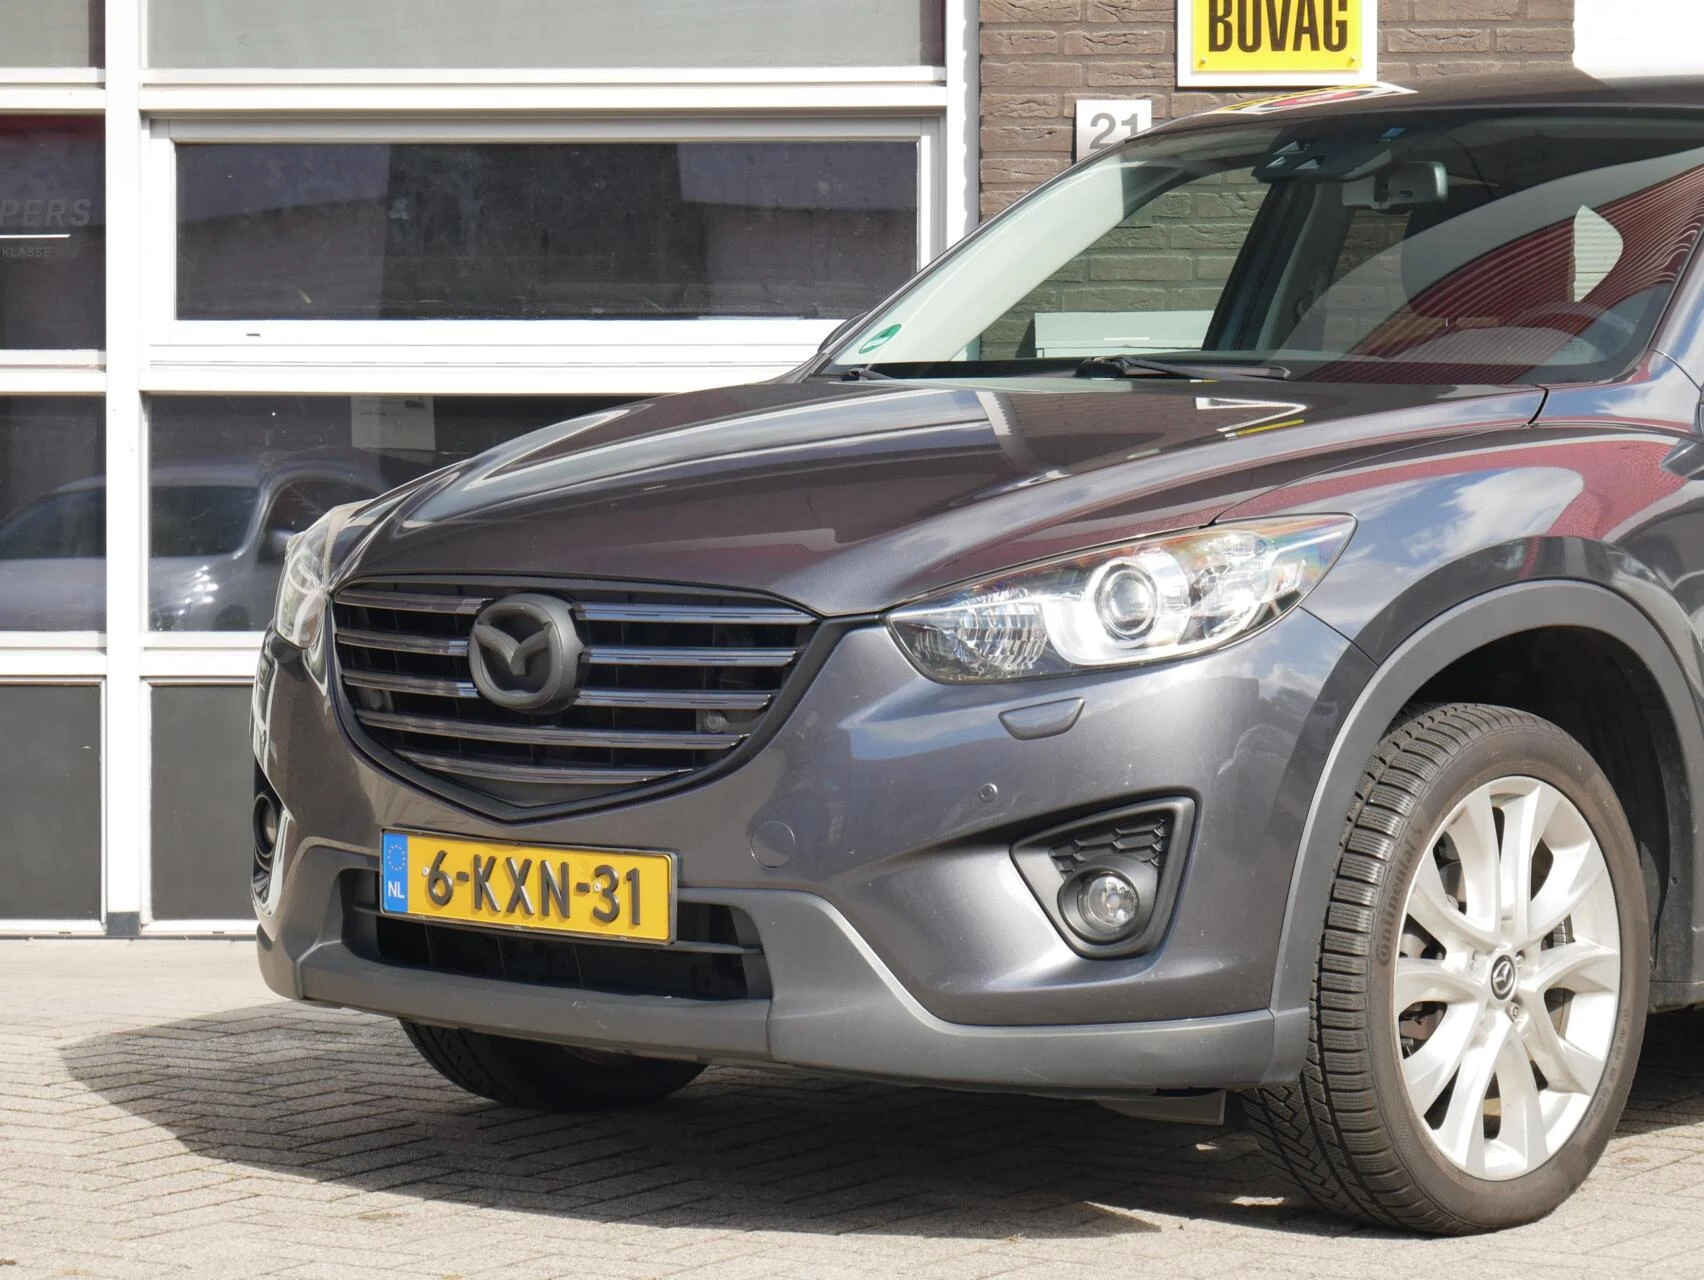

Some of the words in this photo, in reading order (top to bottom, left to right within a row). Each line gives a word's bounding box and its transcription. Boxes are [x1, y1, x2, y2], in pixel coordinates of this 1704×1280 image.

[1208, 0, 1348, 53] BOVAG
[1089, 112, 1138, 150] 21
[0, 198, 91, 227] PERS
[2, 246, 51, 257] KLASSE
[387, 880, 405, 899] NL
[427, 850, 641, 926] 6-KXN-31
